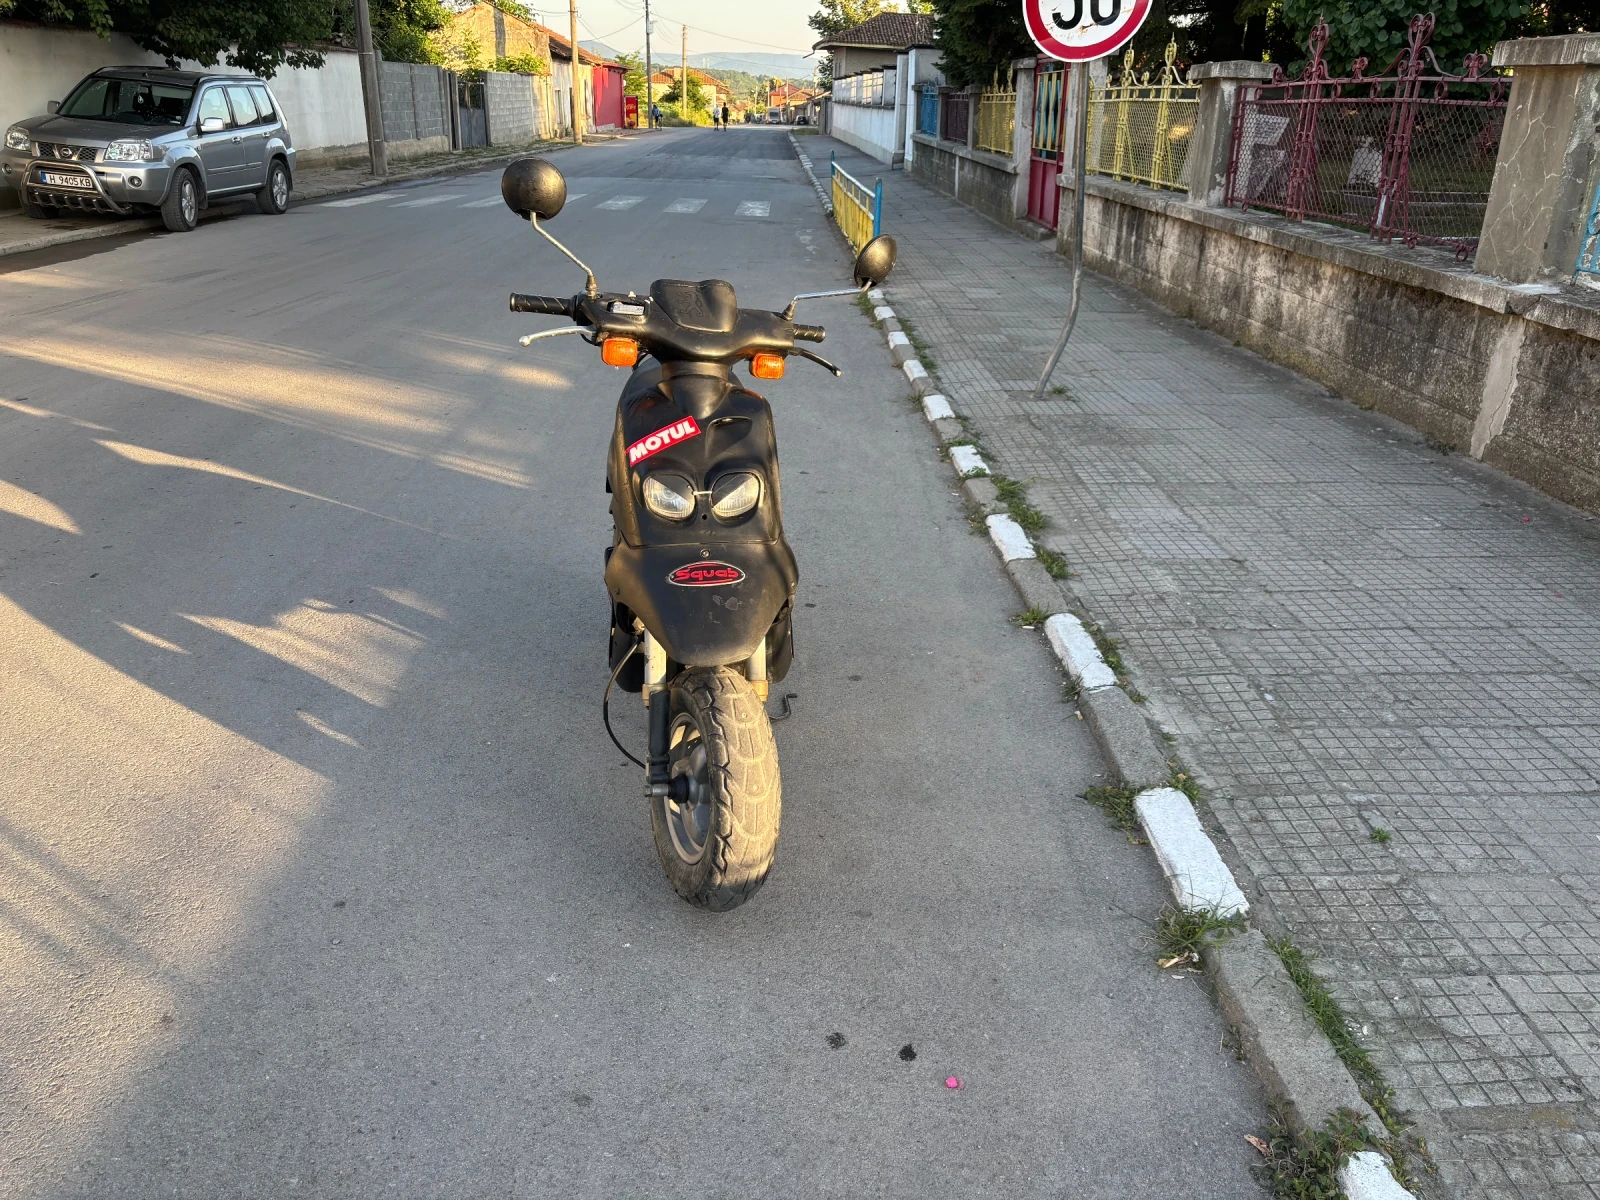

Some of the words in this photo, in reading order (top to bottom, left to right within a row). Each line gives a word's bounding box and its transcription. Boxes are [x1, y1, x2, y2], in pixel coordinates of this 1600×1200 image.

[49, 174, 56, 184] H
[629, 420, 696, 463] MOTUL
[673, 567, 739, 581] Squab
